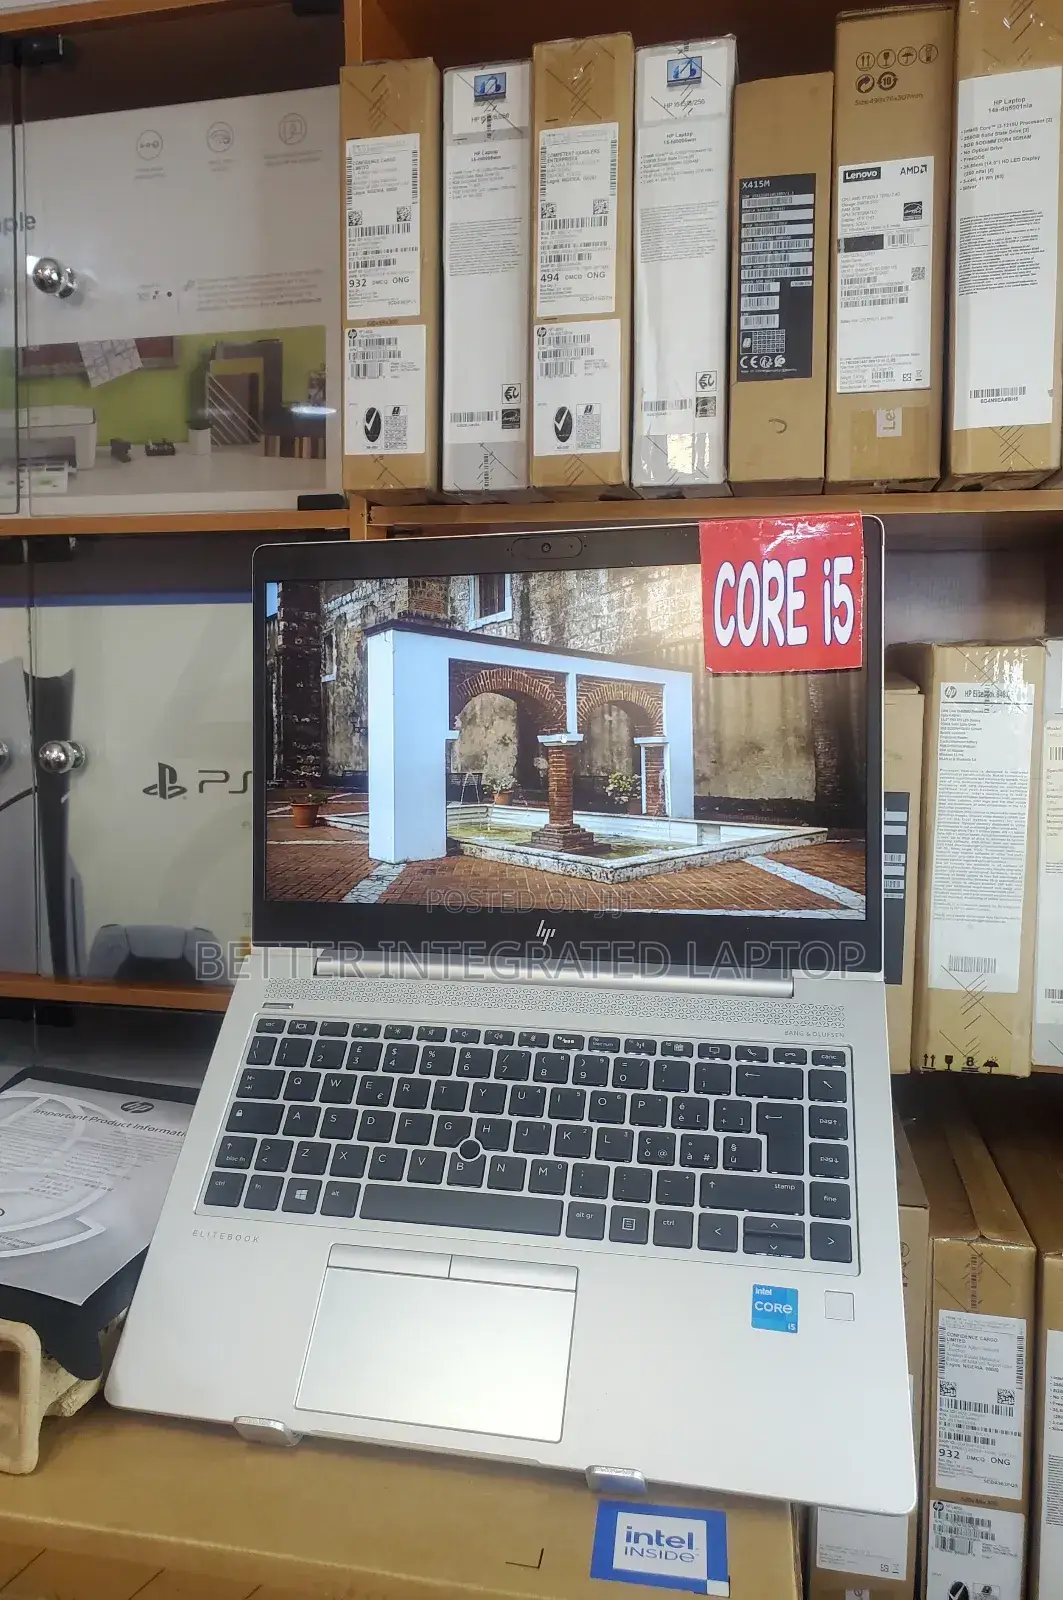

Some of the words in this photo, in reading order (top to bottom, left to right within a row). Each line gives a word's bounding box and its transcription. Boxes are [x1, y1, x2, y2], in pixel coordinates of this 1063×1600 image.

[845, 170, 878, 180] Lenovo
[900, 165, 920, 175] AMD
[741, 180, 771, 189] X415M
[0, 212, 36, 236] ple
[540, 273, 559, 282] 494
[586, 271, 606, 279] ONG
[348, 279, 367, 288] 932
[392, 276, 410, 284] ONG
[714, 556, 808, 647] CORE
[823, 556, 855, 646] i5
[964, 689, 972, 698] HP
[33, 1108, 88, 1122] Important
[88, 1115, 132, 1129] Product
[774, 1183, 796, 1191] stamp
[192, 1229, 260, 1243] ELITEBOOK
[755, 1286, 772, 1296] intel
[787, 1322, 796, 1331] i5
[946, 1332, 979, 1341] CONFIDENCE
[938, 1448, 960, 1459] 932
[990, 1456, 1011, 1466] ONG
[625, 1525, 695, 1551] intel
